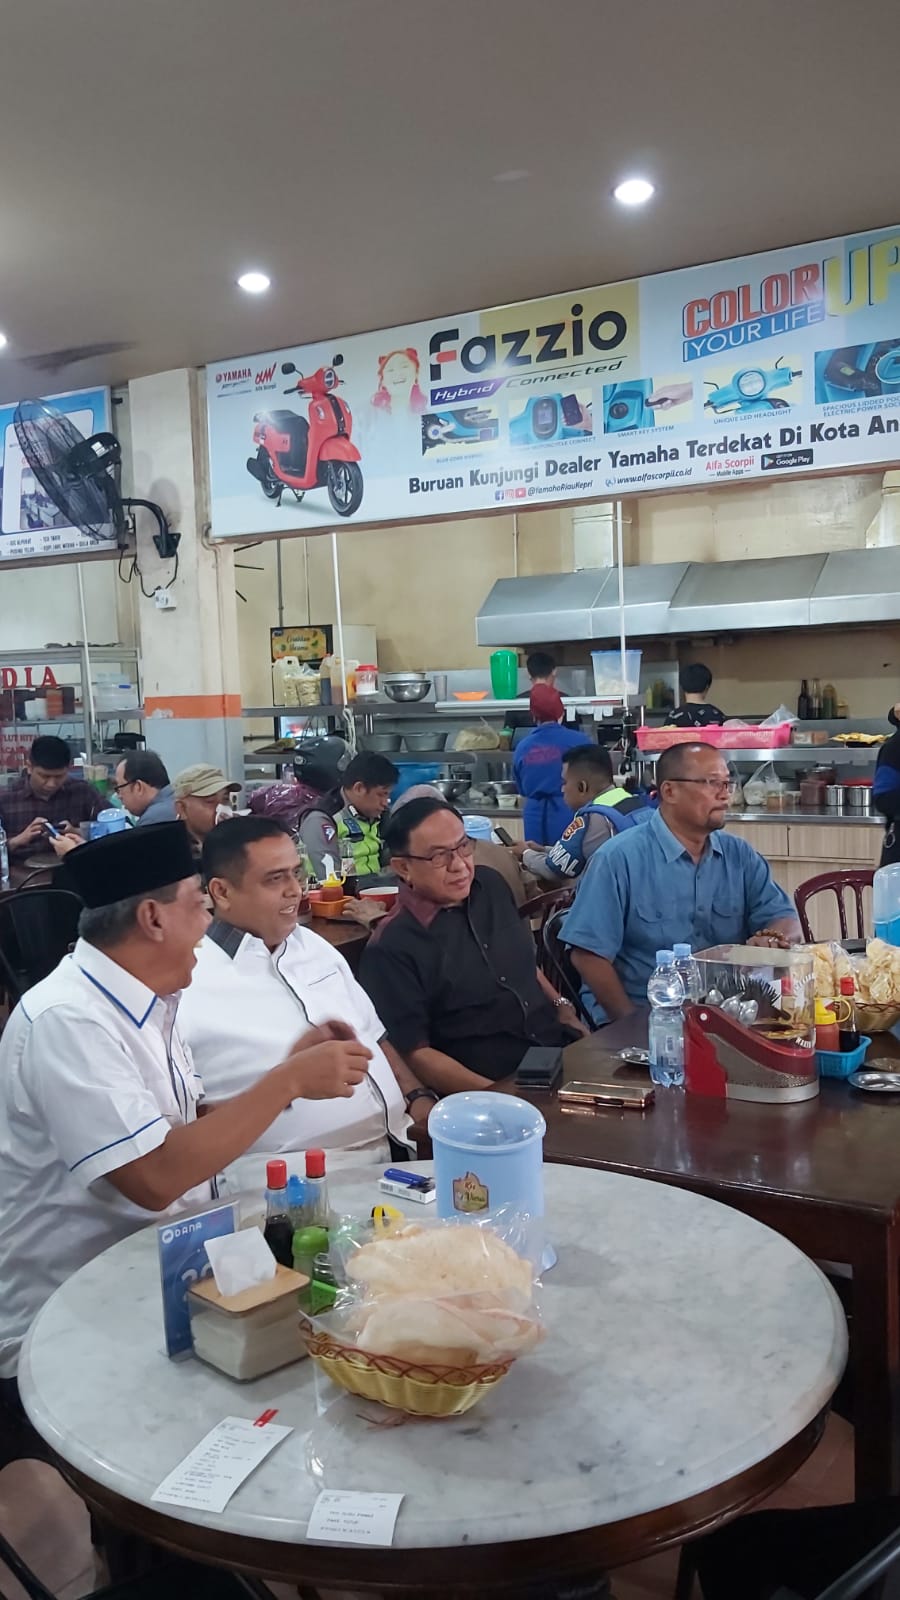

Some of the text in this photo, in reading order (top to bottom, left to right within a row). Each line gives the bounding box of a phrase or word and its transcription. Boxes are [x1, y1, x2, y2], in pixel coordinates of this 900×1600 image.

[683, 263, 820, 338] COLOR
[691, 303, 820, 357] YOUR LIFE
[429, 303, 627, 381] Fazzio
[223, 368, 252, 382] YAMAHA
[434, 361, 623, 401] Hybrid Connected
[713, 408, 792, 425] UNIQUE LED HEADLIGHT
[823, 408, 856, 417] ELECTRIC
[617, 430, 638, 438] SMART
[651, 425, 675, 434] SYSTEM
[409, 415, 900, 493] Buruan Kunjungi Dealer Yamaha Terdekat Di Kota An
[776, 457, 797, 466] Google
[797, 456, 810, 464] Play
[705, 456, 755, 472] Alfa Scorpii
[174, 1222, 203, 1237] DANA
